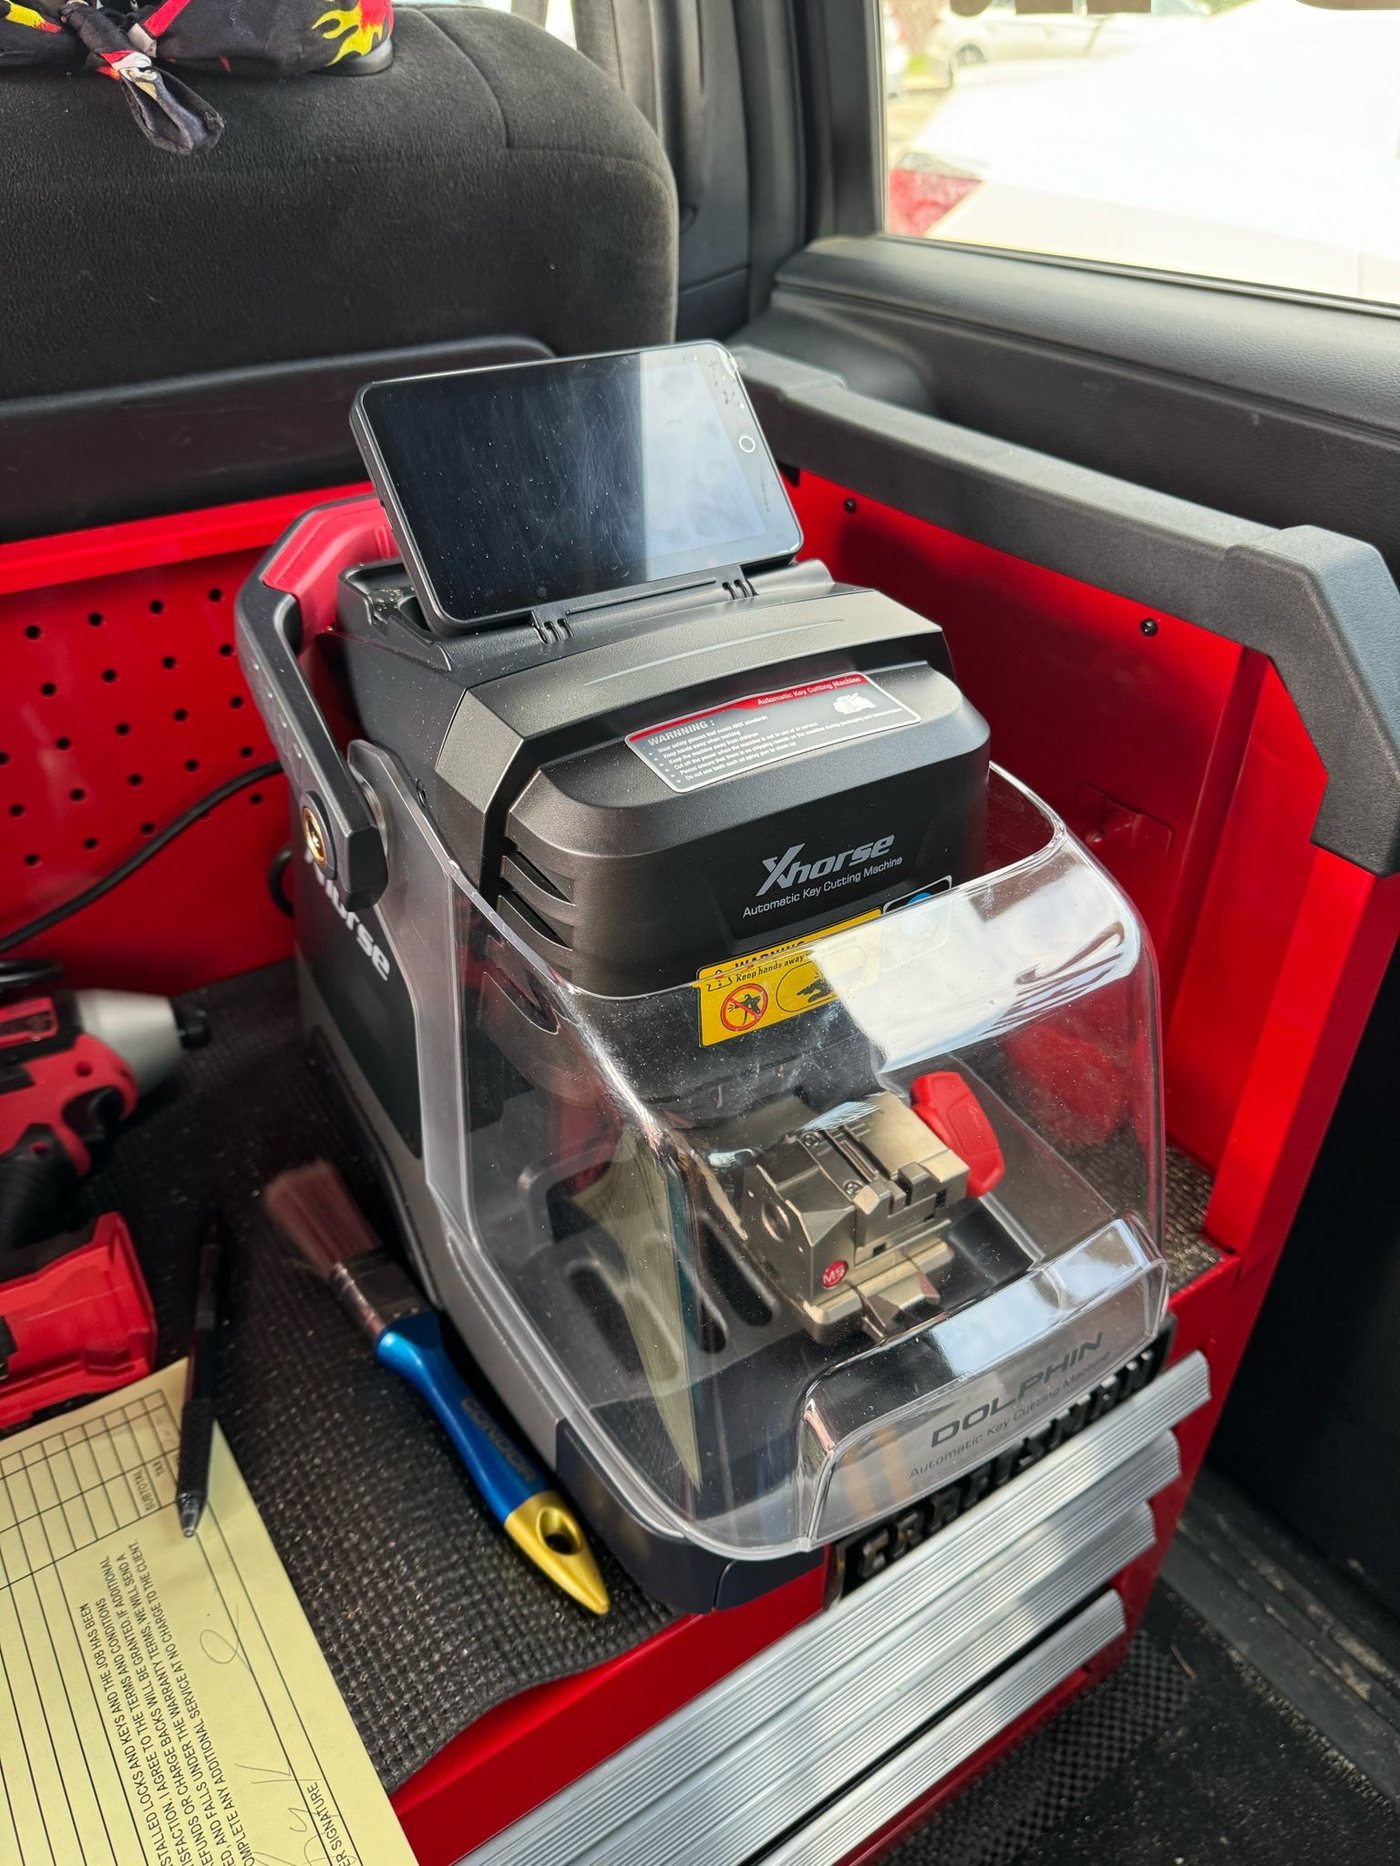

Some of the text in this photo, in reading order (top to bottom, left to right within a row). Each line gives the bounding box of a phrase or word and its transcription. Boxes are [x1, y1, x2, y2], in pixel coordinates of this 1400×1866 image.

[757, 676, 861, 706] Automatic Key Cutting Machine
[648, 721, 708, 746] WARNNING
[755, 834, 895, 897] Xhorse
[742, 856, 903, 918] Automatic Key Cutting Machine
[736, 955, 804, 983] Keep hands away
[931, 1331, 1104, 1448] DOLPHIN
[909, 1432, 983, 1479] Automatic
[987, 1419, 1010, 1437] Key
[115, 1553, 126, 1561] A
[100, 1556, 125, 1608] ADDITIONAL
[118, 1562, 135, 1587] SEND
[139, 1571, 153, 1592] THE
[127, 1585, 142, 1609] WILL
[146, 1590, 158, 1604] TO
[115, 1610, 128, 1619] IF
[134, 1607, 147, 1624] WE
[150, 1602, 172, 1643] CHARGE
[165, 1643, 179, 1660] NO
[135, 1665, 149, 1682] BE
[170, 1660, 184, 1673] AT
[141, 1680, 158, 1709] WILL
[152, 1660, 180, 1719] WARRANTY
[175, 1673, 200, 1719] SERVICE
[79, 1603, 173, 1866] STALLED LOCKS AND KEYS AND THE JOB HAS BEEN
[95, 1598, 194, 1866] ISFACTION. I AGREE TO THE TERMS AND CONDITIONS
[150, 1707, 172, 1747] BACKS
[172, 1717, 188, 1742] THE
[181, 1740, 203, 1782] UNDER
[193, 1718, 225, 1784] ADDITIONAL
[163, 1746, 188, 1795] CHARGE
[180, 1795, 195, 1815] OR
[195, 1781, 217, 1820] FALLS
[216, 1786, 235, 1810] ANY
[307, 1782, 343, 1850] SIGNATURE
[209, 1819, 227, 1845] AND
[220, 1844, 236, 1866] ED,
